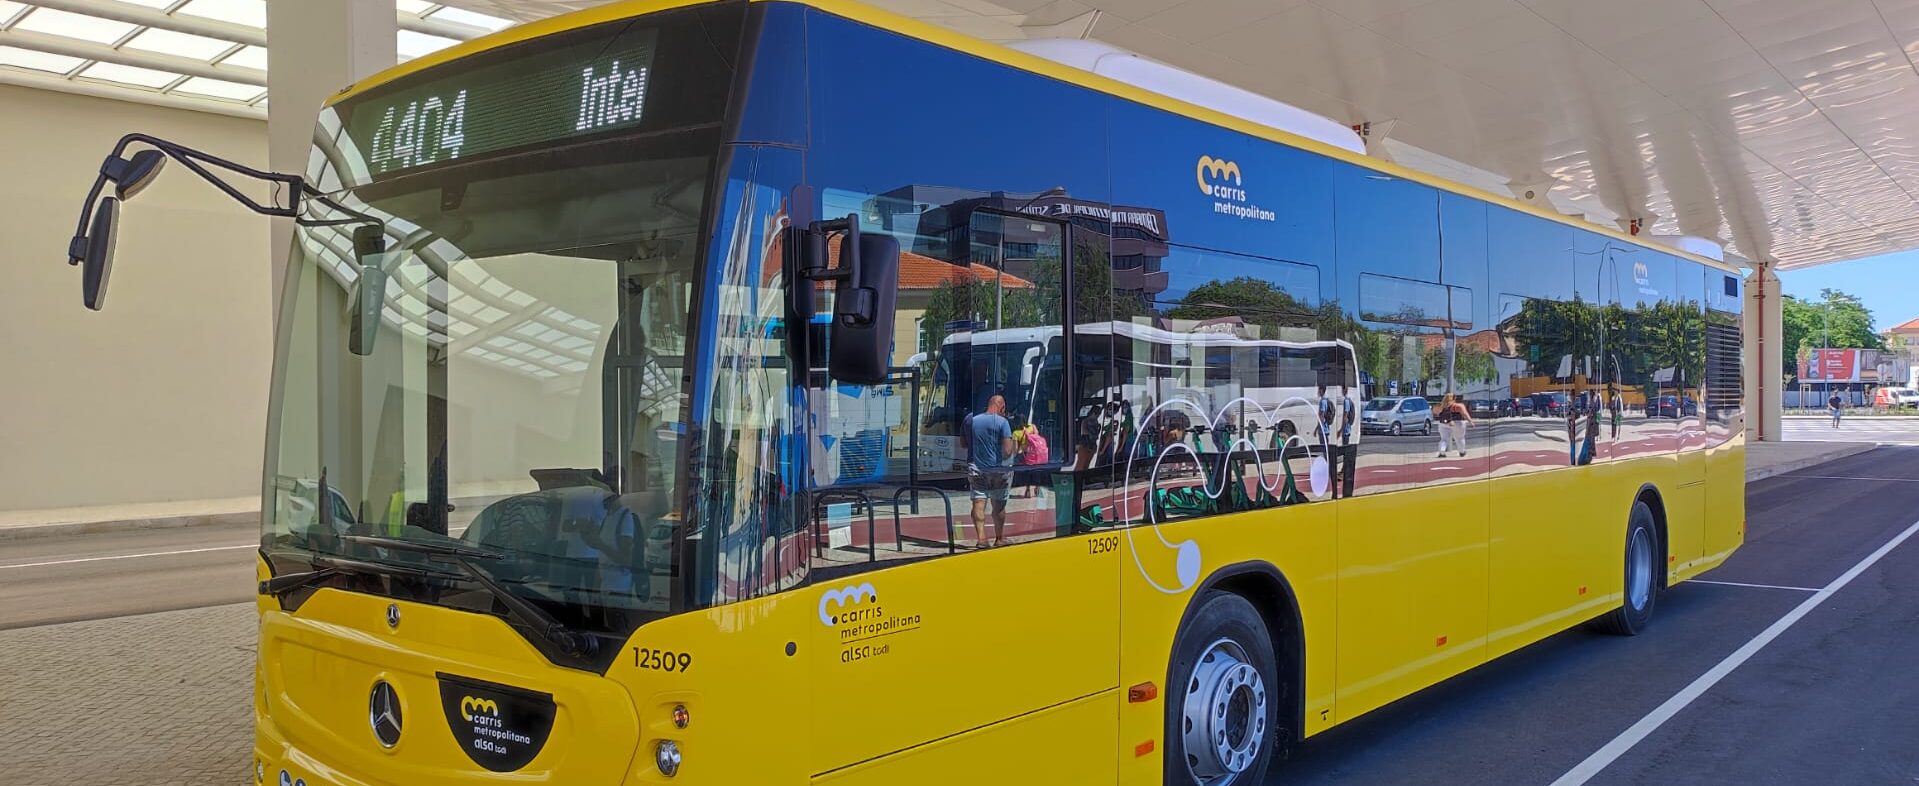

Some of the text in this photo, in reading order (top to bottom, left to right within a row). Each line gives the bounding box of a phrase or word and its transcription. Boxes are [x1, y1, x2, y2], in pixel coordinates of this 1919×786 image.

[371, 90, 466, 172] 4404
[1214, 185, 1246, 202] carris
[1214, 202, 1275, 221] metropolitana
[1088, 537, 1118, 554] 12509
[841, 606, 882, 624] carris
[841, 615, 921, 639] metropolitana
[633, 647, 691, 673] 12509
[841, 646, 870, 663] alsa
[474, 714, 502, 728] carris
[474, 726, 530, 744] metropolitana
[474, 739, 493, 751] alsa
